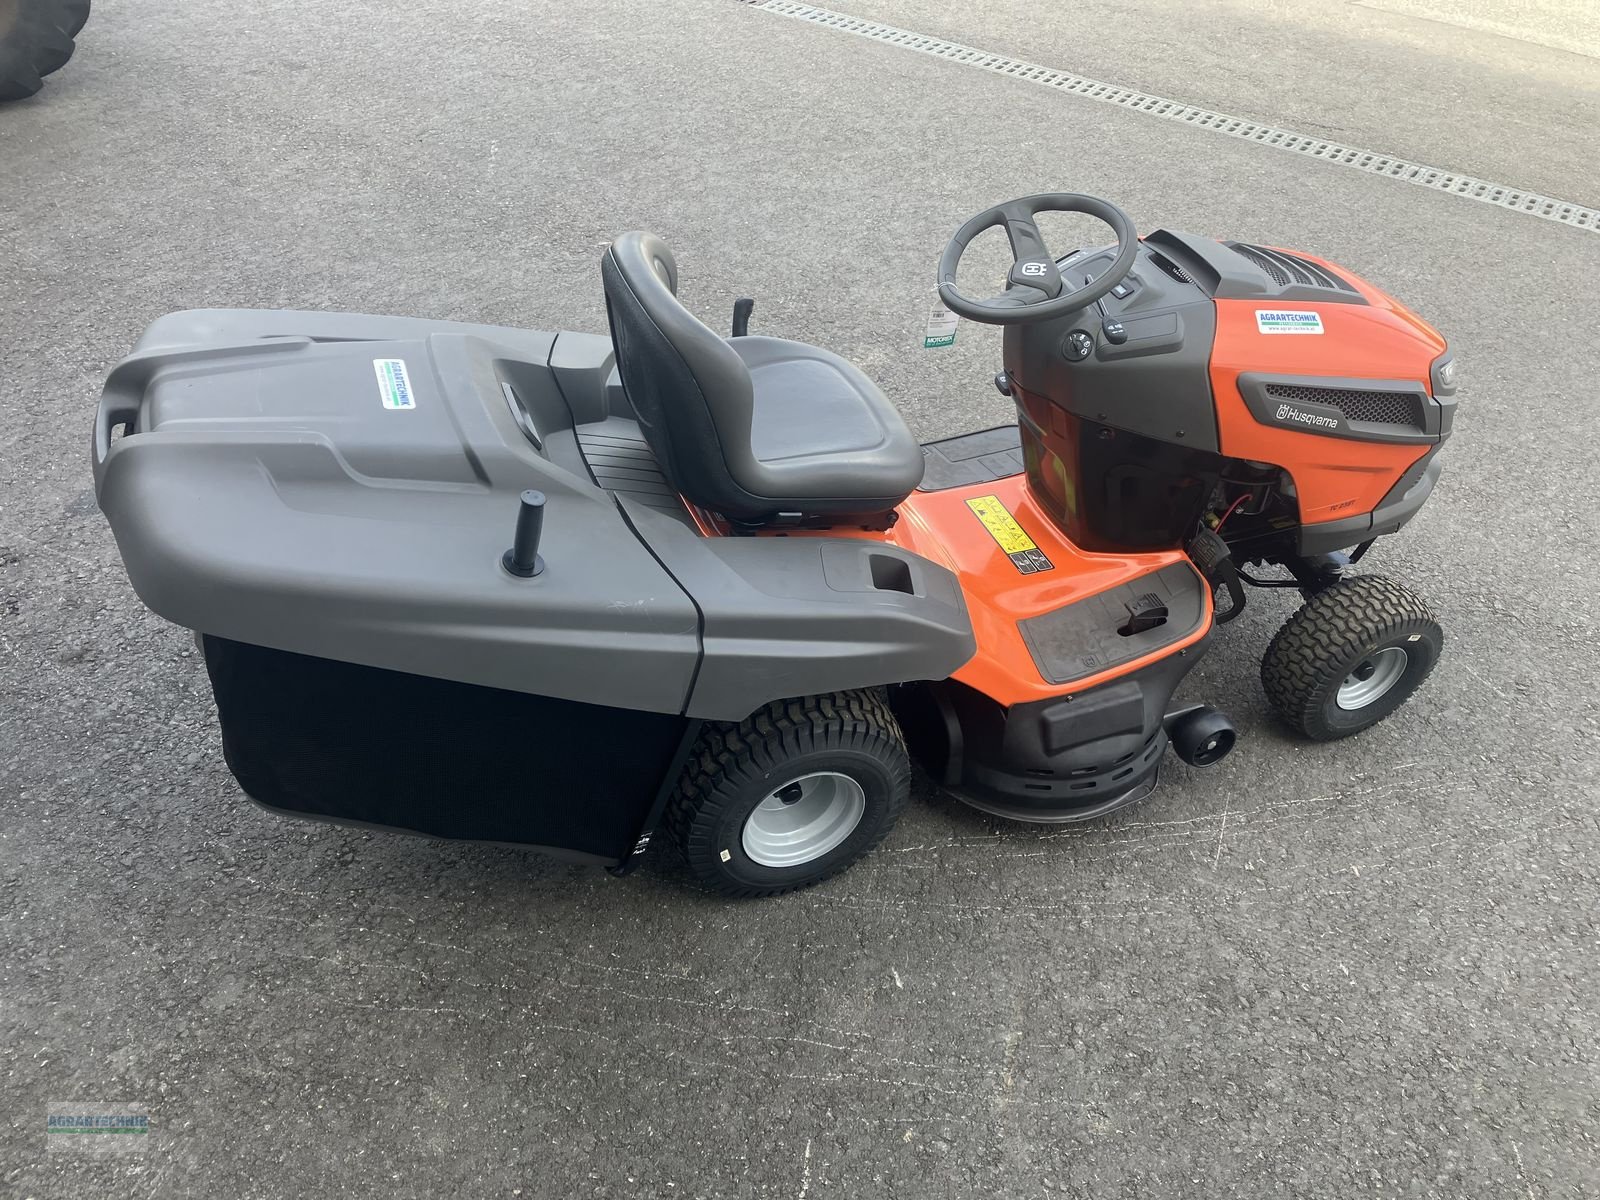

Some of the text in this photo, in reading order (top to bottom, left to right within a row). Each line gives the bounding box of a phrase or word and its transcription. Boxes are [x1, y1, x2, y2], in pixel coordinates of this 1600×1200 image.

[1260, 313, 1318, 322] AGRARTECHNIK
[391, 361, 411, 406] AGRARTECHNIK
[1287, 408, 1338, 429] Husqvarna
